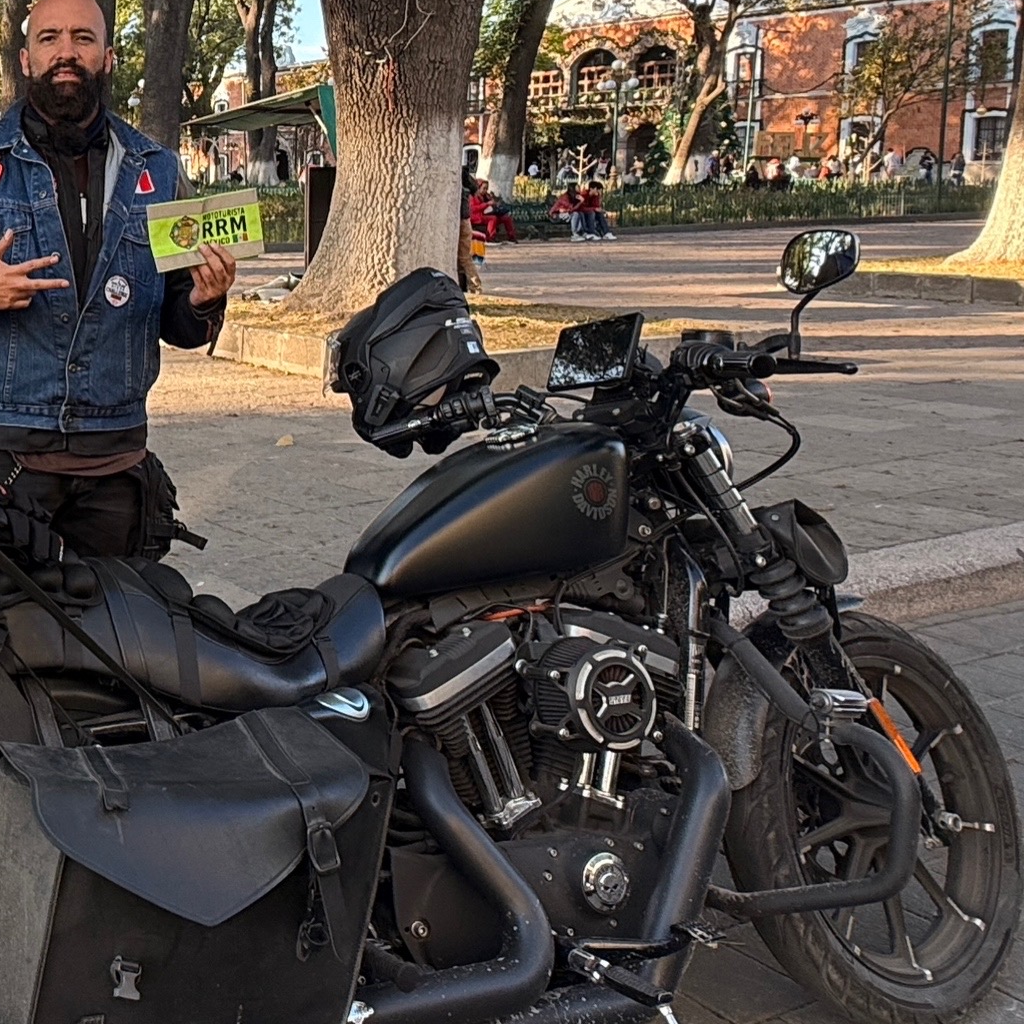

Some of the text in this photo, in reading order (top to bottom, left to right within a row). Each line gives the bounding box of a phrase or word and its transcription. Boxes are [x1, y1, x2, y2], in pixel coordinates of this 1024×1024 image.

[202, 207, 246, 221] MOTOTURISTA
[202, 215, 247, 240] RRM
[570, 463, 614, 488] HARLEY
[572, 489, 618, 520] DAVIDSON
